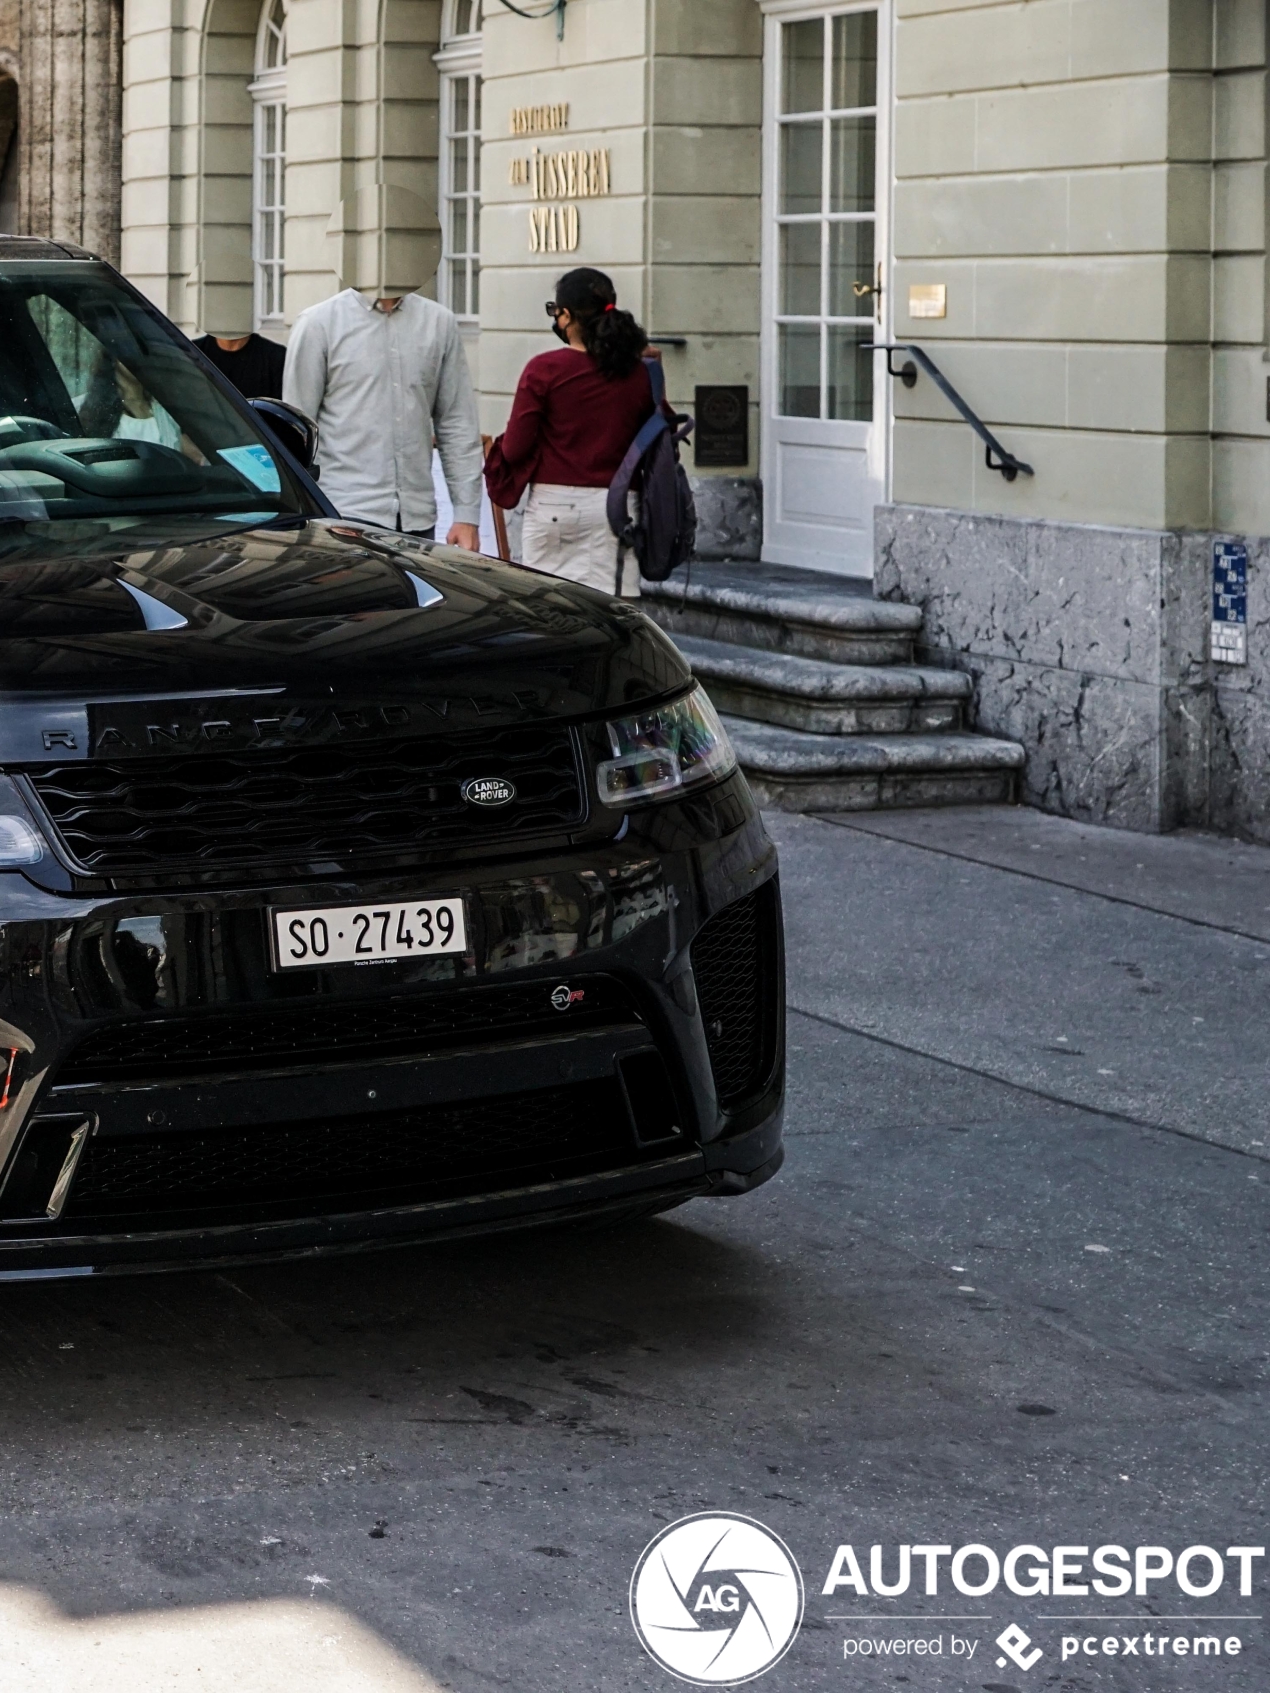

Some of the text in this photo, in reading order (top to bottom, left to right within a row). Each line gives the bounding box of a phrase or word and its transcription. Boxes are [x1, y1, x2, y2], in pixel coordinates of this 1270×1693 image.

[529, 204, 579, 252] STAND
[41, 690, 546, 751] RANGE ROVER
[475, 781, 499, 792] LAND
[480, 789, 509, 800] ROVER
